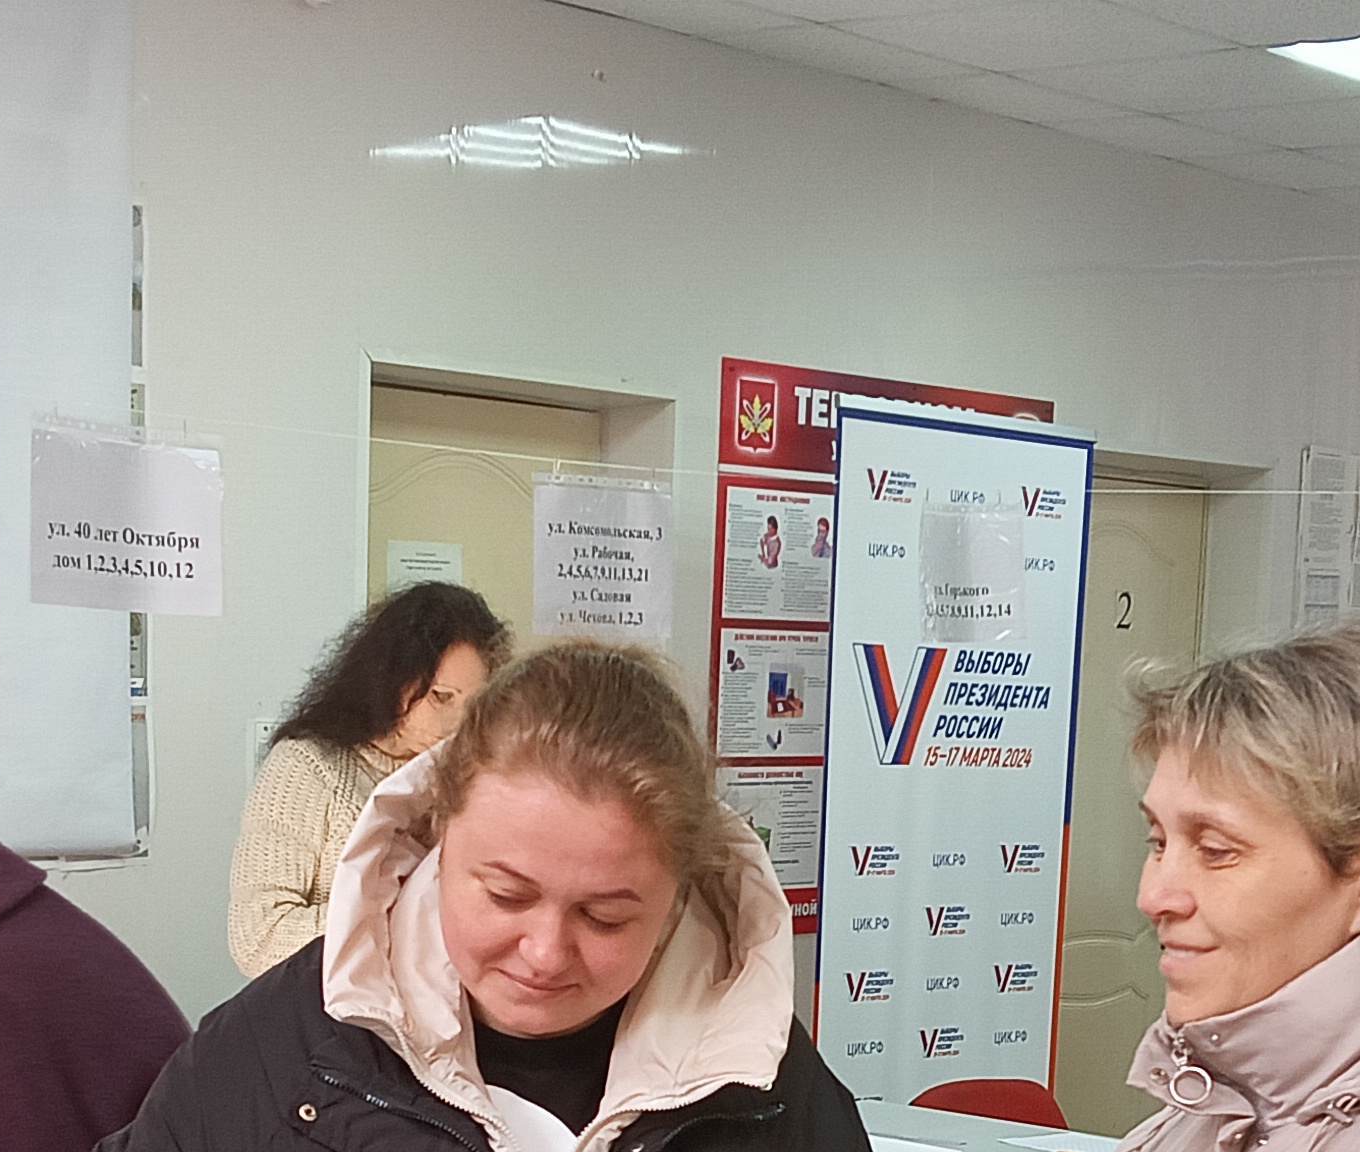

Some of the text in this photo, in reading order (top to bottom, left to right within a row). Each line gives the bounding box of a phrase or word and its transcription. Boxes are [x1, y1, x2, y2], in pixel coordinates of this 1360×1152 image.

[950, 489, 985, 505] ЦИК.РФ
[48, 522, 200, 552] ул. 40 лет Октября
[548, 522, 565, 537] ул.
[656, 527, 662, 540] 3
[573, 547, 589, 561] ул.
[868, 542, 906, 558] ЦИК.РФ
[52, 554, 81, 569] дом
[572, 590, 588, 604] ул.
[1116, 591, 1132, 629] 2
[954, 650, 1032, 676] ВЫБОРЫ
[943, 682, 1051, 712] ПРЕЗИДЕНТА
[932, 714, 1004, 740] РОССИИ
[960, 747, 1002, 767] МАРТА
[1002, 748, 1032, 768] 2024
[932, 853, 966, 868] ЦИК.РФ
[852, 916, 889, 933] ЦИК.РФ
[1000, 912, 1034, 928] ЦИК.РФ
[926, 977, 960, 992] ЦИК.РФ
[994, 1030, 1028, 1045] ЦИК.РФ
[847, 1041, 884, 1057] ЦИК.РФ
